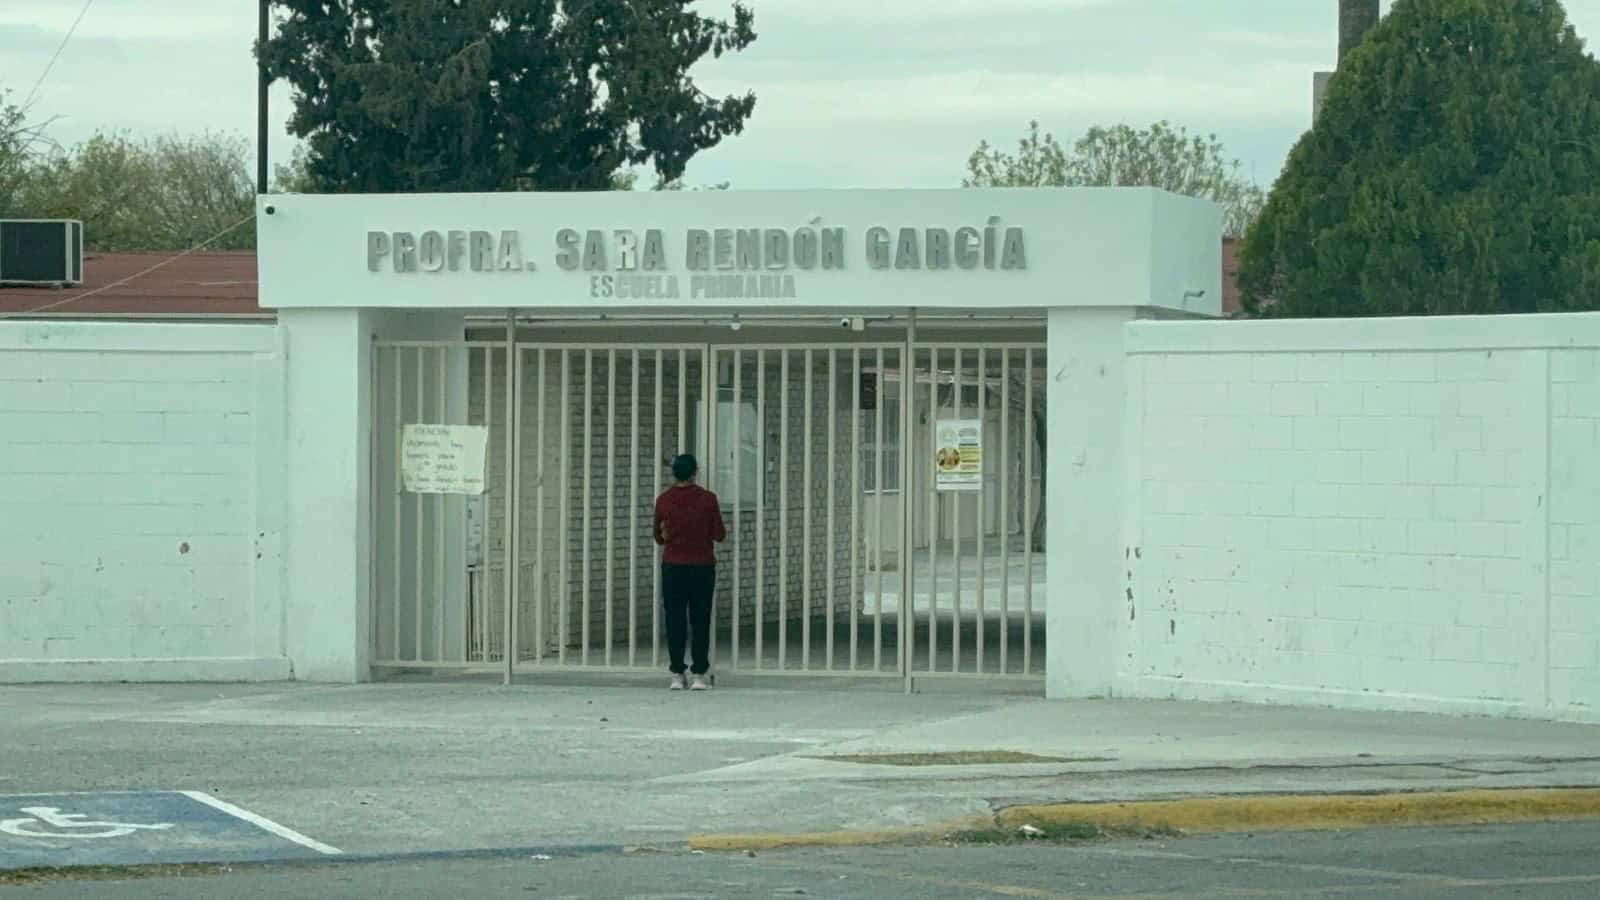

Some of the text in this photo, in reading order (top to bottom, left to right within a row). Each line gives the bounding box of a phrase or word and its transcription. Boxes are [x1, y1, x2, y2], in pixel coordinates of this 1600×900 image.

[367, 215, 1026, 272] PROFRA. SARA RENDÓN GARCÍA
[590, 275, 796, 299] ESCUELA PRIMARIA
